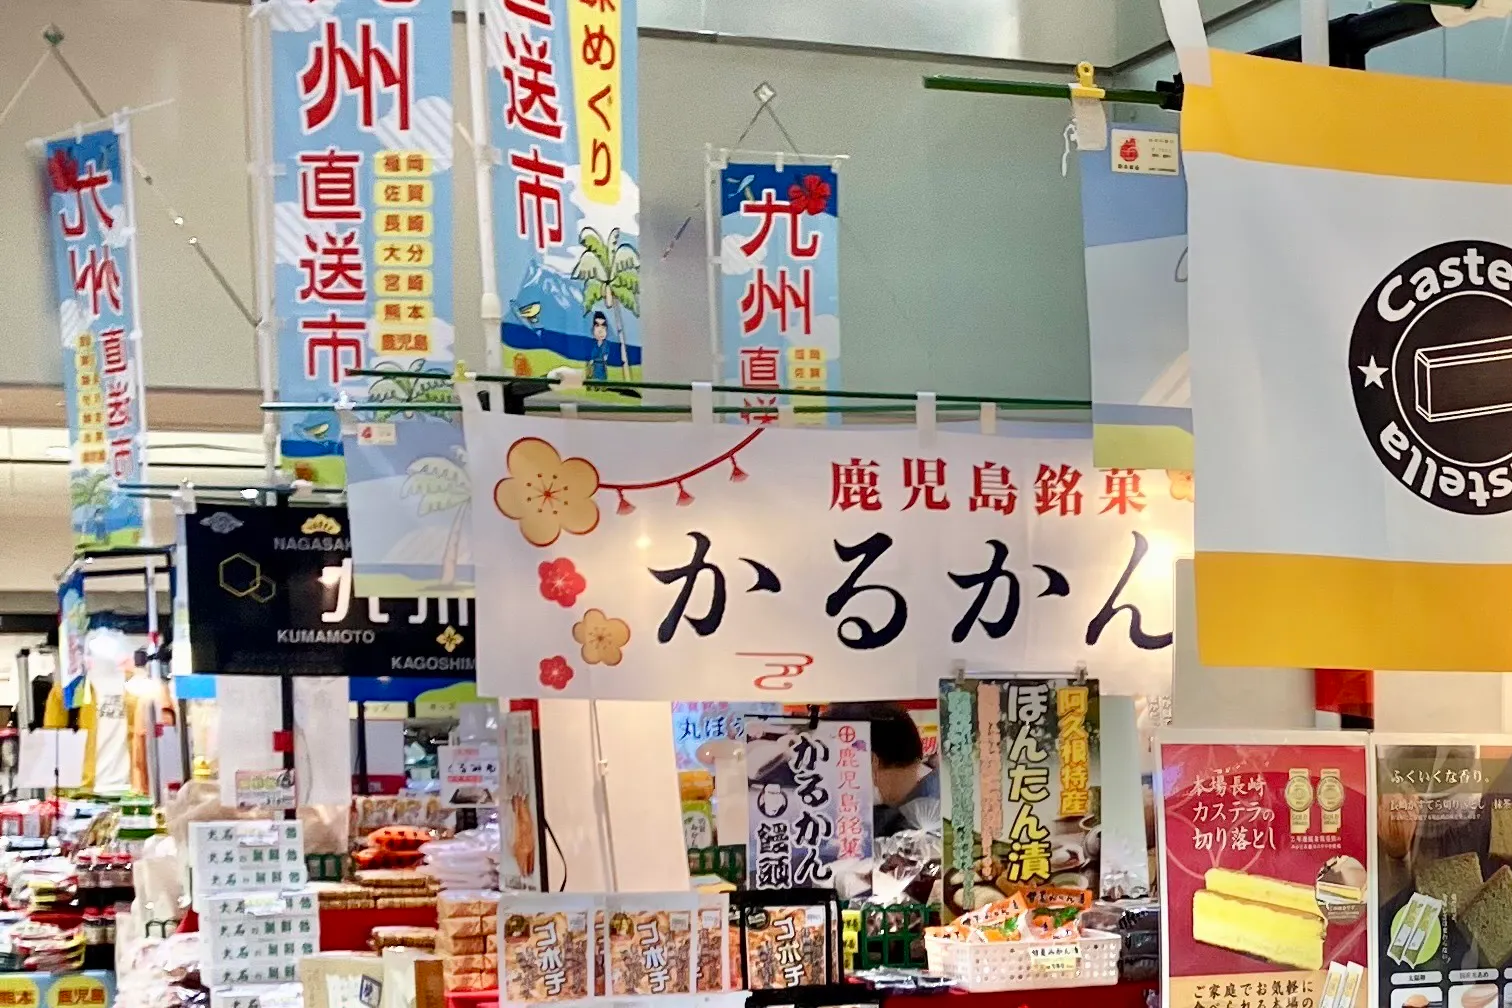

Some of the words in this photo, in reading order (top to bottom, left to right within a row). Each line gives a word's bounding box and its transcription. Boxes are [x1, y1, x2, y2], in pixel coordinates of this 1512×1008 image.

[829, 458, 1147, 516] 鹿児島銘菓
[274, 537, 352, 551] NAGASAK
[647, 531, 1173, 650] かるかん
[277, 629, 376, 644] KUMAMOTO
[391, 655, 476, 671] KAGOSHIM
[1057, 688, 1089, 815] 阿久根特産
[1008, 684, 1051, 882] ぼんたん漬
[1190, 774, 1267, 797] 本場長崎
[792, 733, 833, 884] かるかん
[1192, 801, 1275, 823] カステラの
[1193, 827, 1276, 850] 切り落とし
[1193, 979, 1314, 1000] ご家庭でお気軽に
